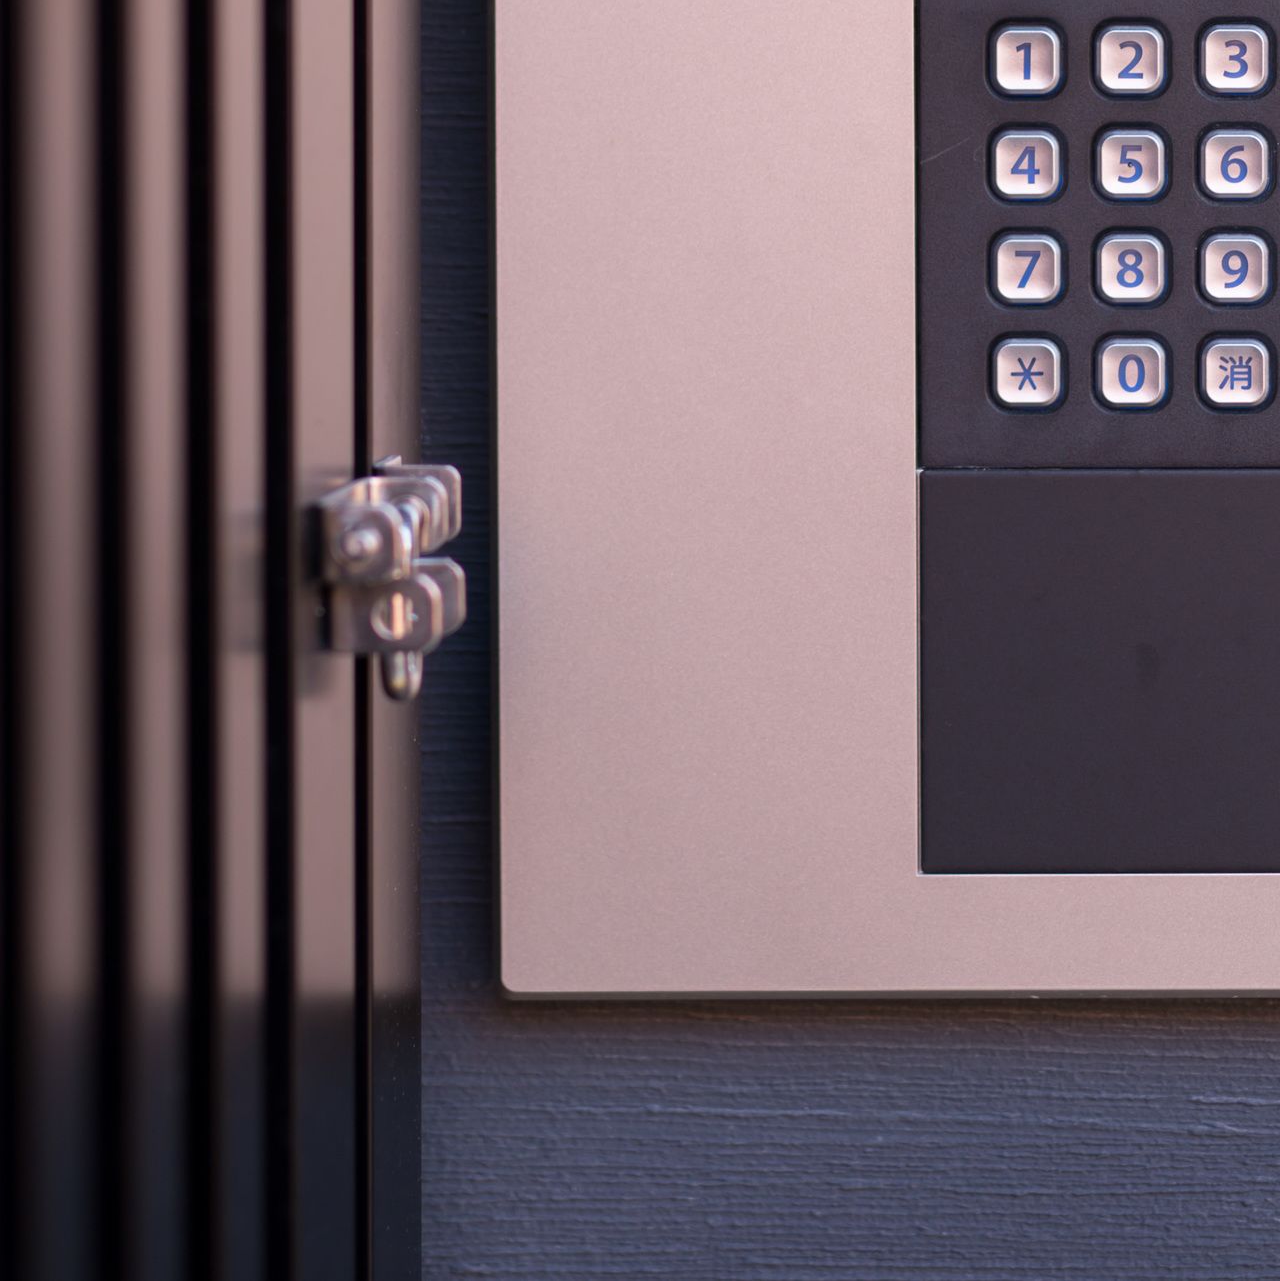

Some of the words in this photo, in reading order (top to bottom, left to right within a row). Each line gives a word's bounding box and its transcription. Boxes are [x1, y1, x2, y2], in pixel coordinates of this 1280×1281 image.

[1014, 43, 1033, 81] 1
[1117, 41, 1145, 80] 2
[1222, 40, 1249, 80] 3
[1009, 146, 1041, 186] 4
[1118, 145, 1144, 185] 5
[1220, 145, 1249, 185] 6
[1014, 250, 1041, 289] 7
[1116, 250, 1145, 289] 8
[1221, 249, 1249, 289] 9
[1118, 355, 1146, 394] 0
[1218, 355, 1254, 392] 消
